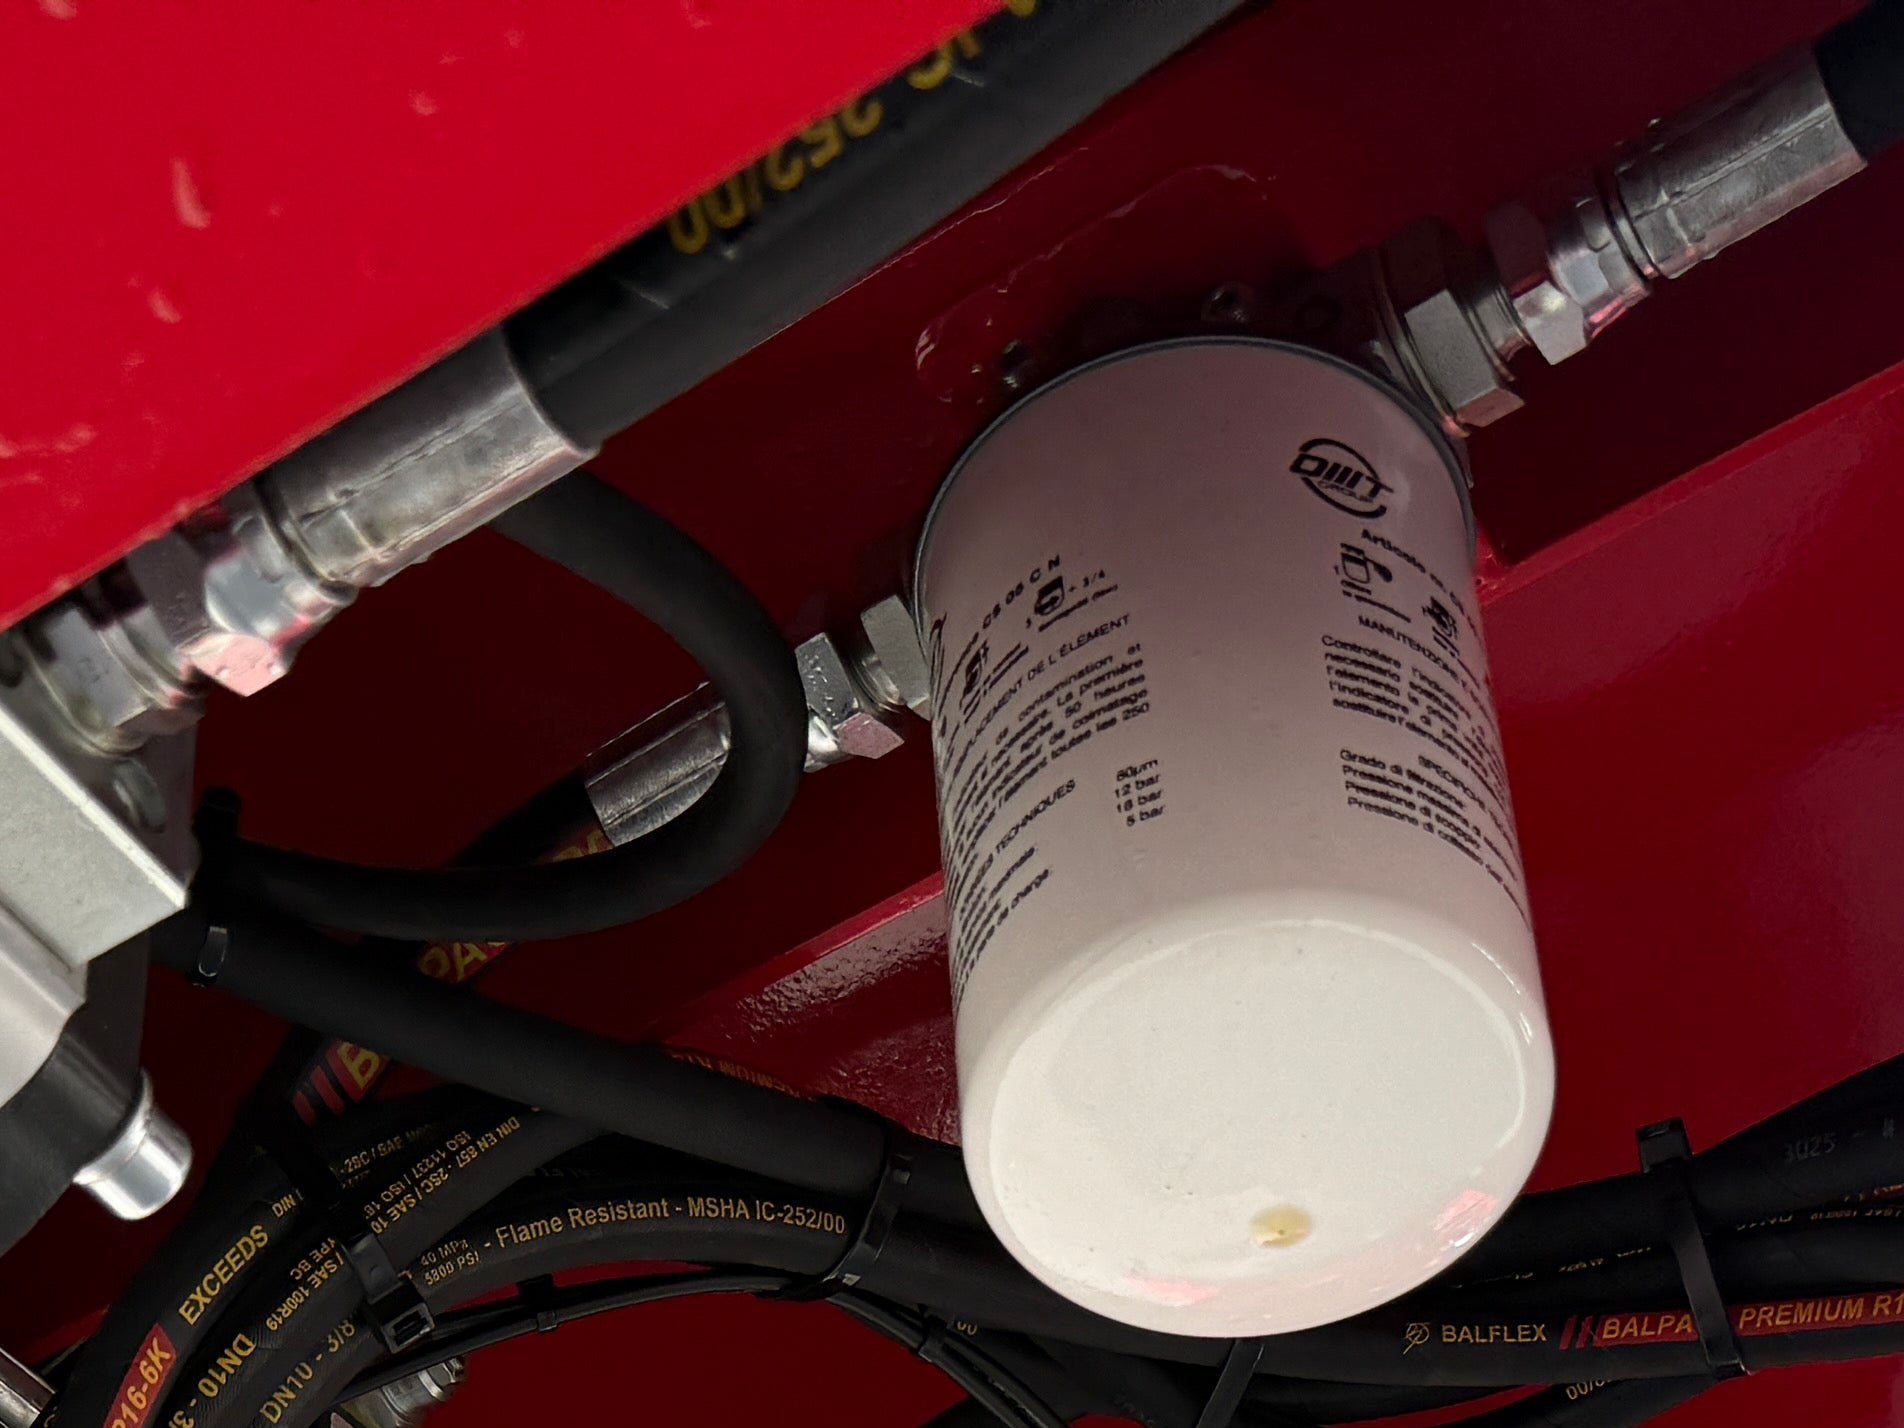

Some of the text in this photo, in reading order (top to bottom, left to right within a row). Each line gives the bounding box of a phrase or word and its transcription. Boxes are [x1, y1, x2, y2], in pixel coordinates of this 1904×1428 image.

[1122, 702, 1150, 721] 250
[1135, 774, 1161, 791] bar
[1342, 766, 1413, 794] Pressione
[1137, 789, 1163, 806] bar
[1348, 797, 1419, 826] Pressione
[1139, 804, 1166, 822] bar
[496, 1214, 563, 1248] Flame
[568, 1196, 670, 1229] Resistant
[687, 1197, 750, 1220] MSHA
[756, 1201, 846, 1235] IC-252/00
[178, 1224, 270, 1326] EXCEEDS
[290, 1256, 311, 1280] BC
[266, 1284, 311, 1332] 100R19
[1441, 1322, 1547, 1344] BALFLEX
[1602, 1315, 1694, 1340] BALPA
[1739, 1297, 1864, 1330] PREMIUM
[197, 1332, 256, 1399] DN10
[259, 1361, 314, 1424] DN10
